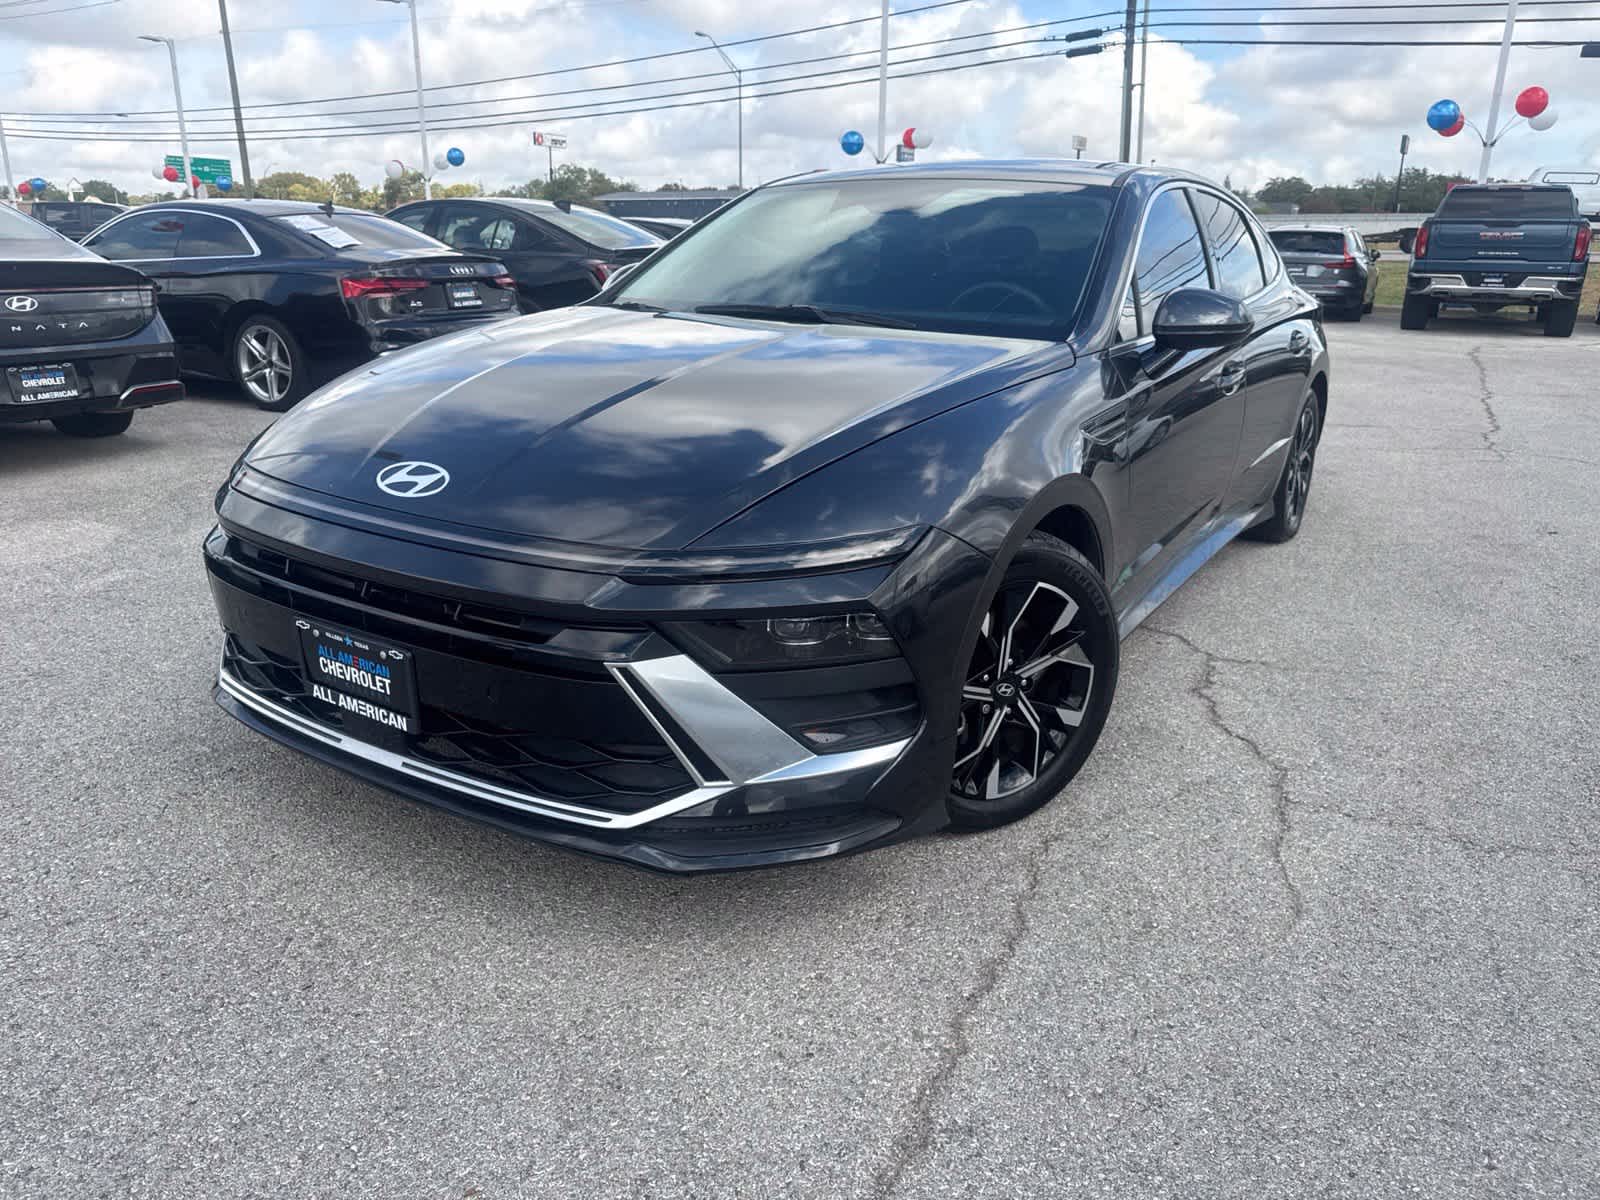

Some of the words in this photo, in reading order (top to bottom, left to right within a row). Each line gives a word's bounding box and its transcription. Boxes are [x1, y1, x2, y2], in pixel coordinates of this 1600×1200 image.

[22, 376, 65, 387] CHEVROLET
[37, 390, 78, 400] AMERICAN
[317, 644, 336, 660] ALL
[338, 651, 390, 678] AMERICAN
[319, 656, 391, 695] CHEVROLET
[313, 684, 336, 705] ALL
[338, 693, 408, 732] AMERICAN
